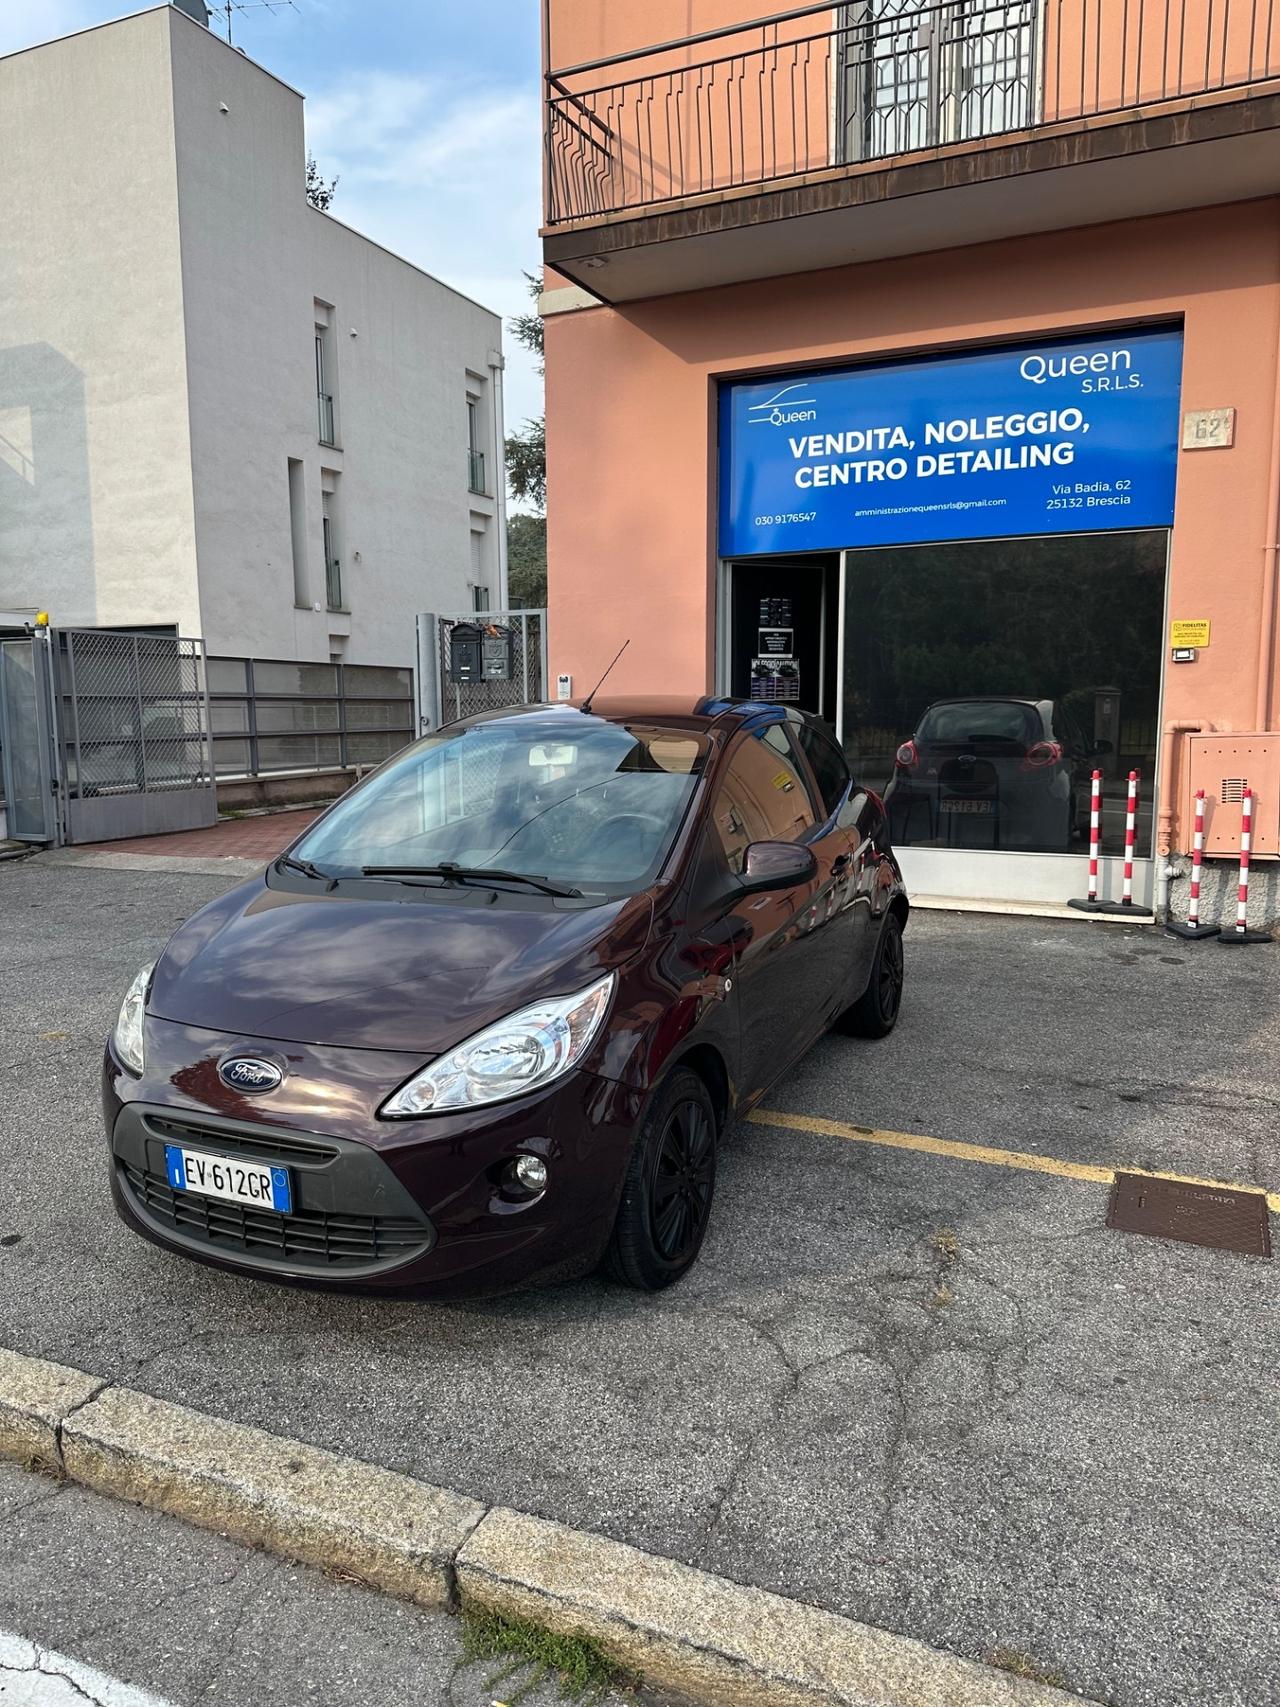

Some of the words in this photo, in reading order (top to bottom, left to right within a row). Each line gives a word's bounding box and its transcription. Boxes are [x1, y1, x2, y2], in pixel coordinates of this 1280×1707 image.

[1020, 349, 1131, 384] Queen
[1081, 373, 1144, 393] S.R.L.S.
[770, 409, 816, 426] Queen
[788, 426, 915, 459] VENDITA,
[925, 407, 1090, 445] NOLEGGIO,
[795, 457, 908, 489] CENTRO
[917, 442, 1074, 478] DETAILING
[1053, 485, 1071, 495] Via
[1075, 482, 1112, 494] Badia,
[1115, 480, 1131, 490] 62
[855, 498, 1007, 517] amministrazionequeensrls@gmail.com
[1047, 498, 1083, 510] 25132
[1087, 495, 1131, 507] Brescia
[755, 517, 773, 526] 030
[775, 511, 816, 524] 9176547
[231, 1063, 264, 1084] Ford
[212, 1164, 272, 1201] 612GR
